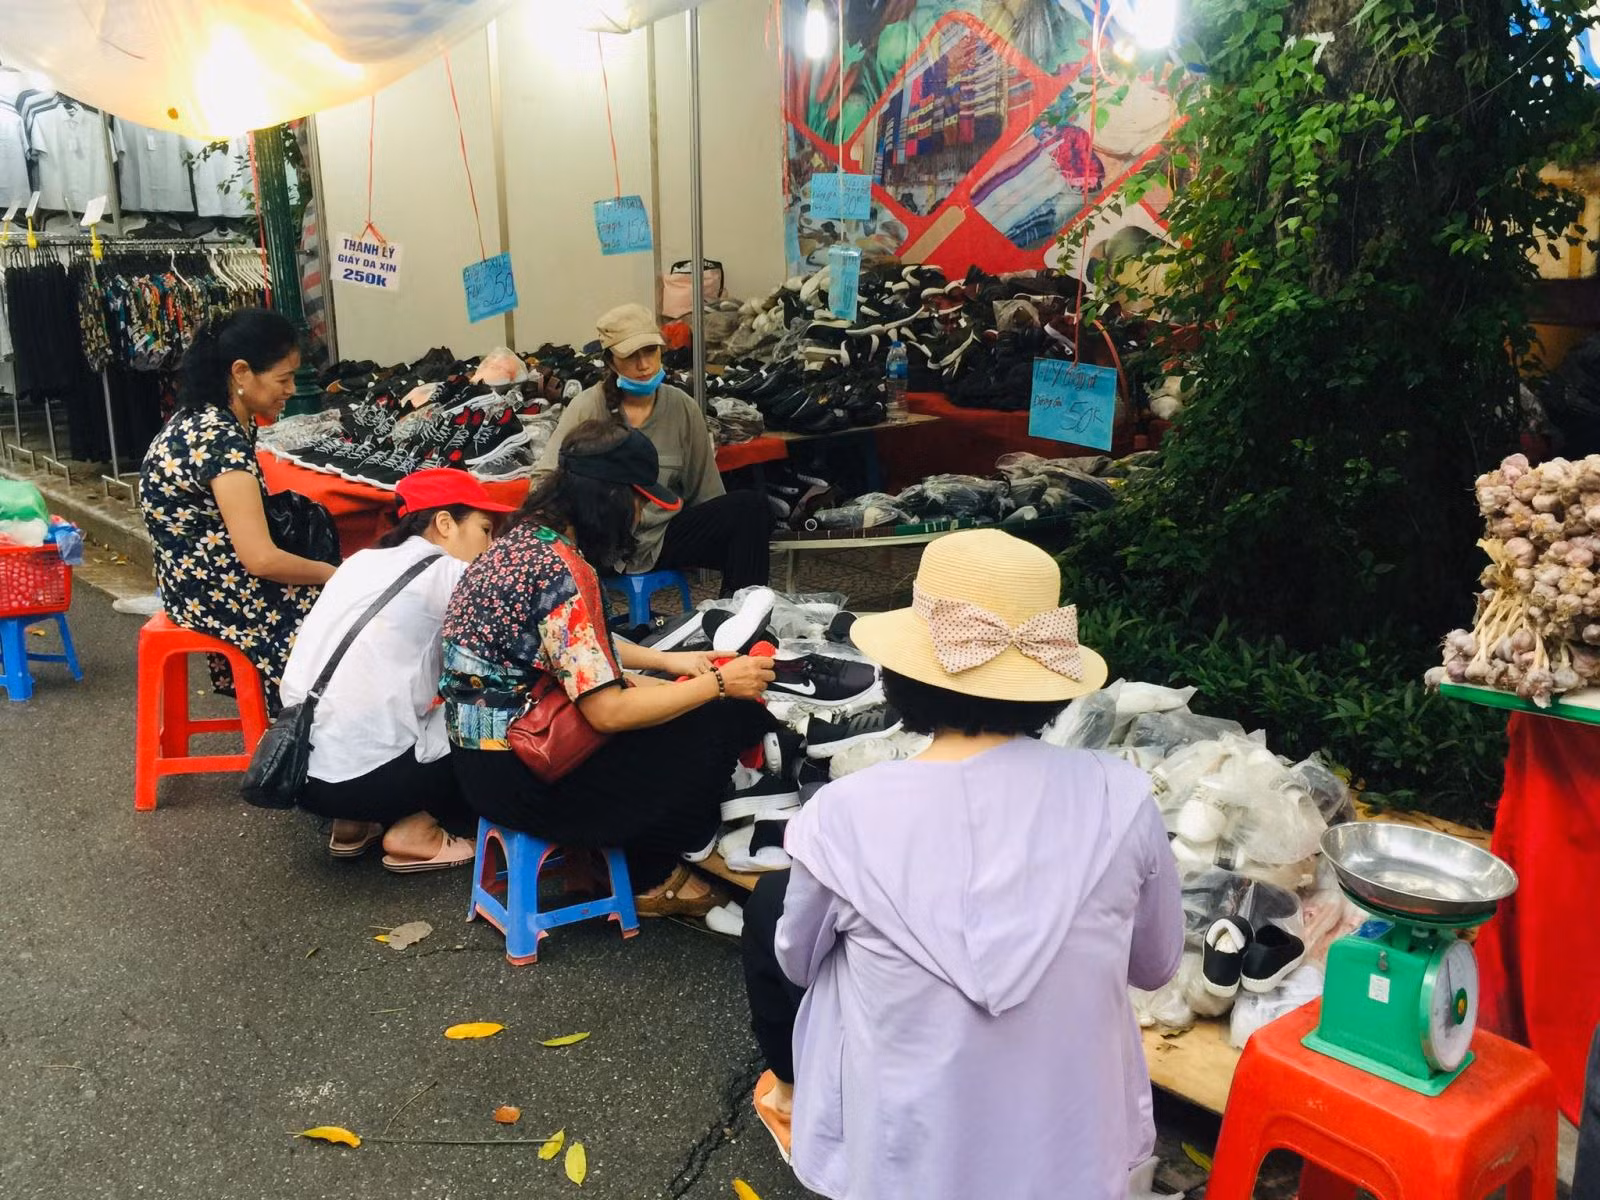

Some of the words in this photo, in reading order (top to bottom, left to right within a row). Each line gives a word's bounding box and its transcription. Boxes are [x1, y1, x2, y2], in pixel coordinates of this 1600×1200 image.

[343, 238, 379, 256] THANH
[363, 259, 376, 269] DA
[343, 268, 387, 287] 250k
